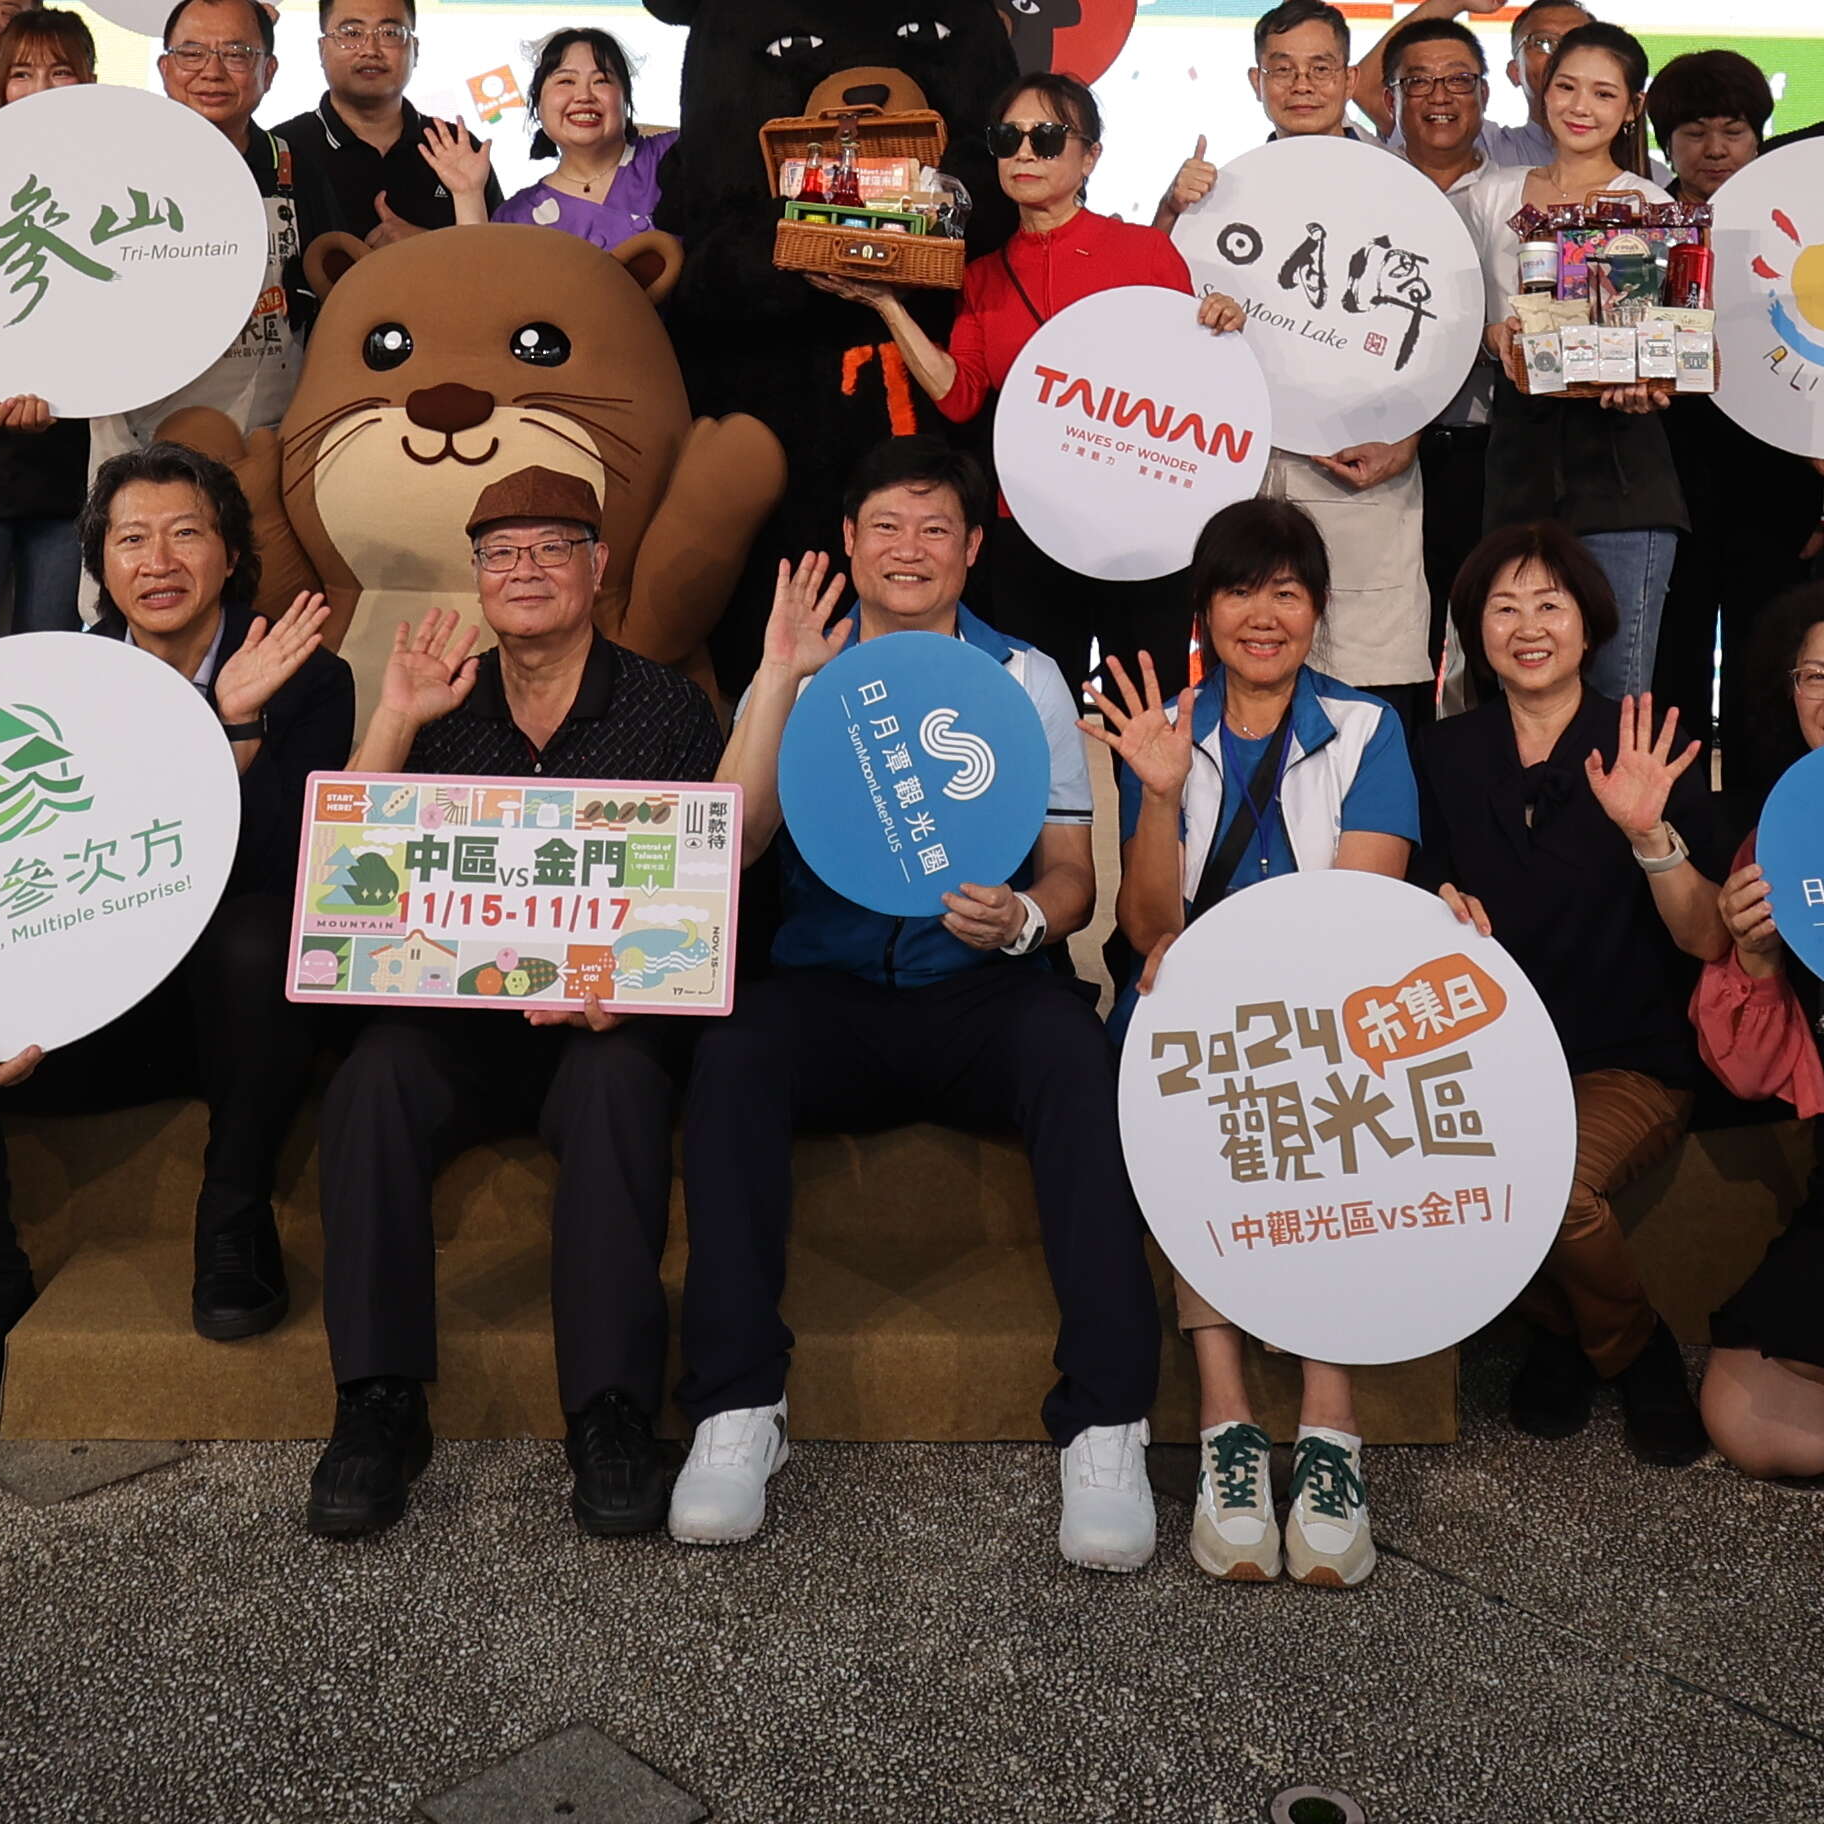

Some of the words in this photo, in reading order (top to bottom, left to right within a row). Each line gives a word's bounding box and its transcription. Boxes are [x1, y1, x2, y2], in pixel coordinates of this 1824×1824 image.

[120, 240, 238, 262] Tri-Mountain
[1242, 297, 1297, 332] Moon
[1300, 320, 1348, 350] Lake
[1034, 364, 1254, 464] TAIWAN
[1065, 425, 1113, 449] WAVES
[1115, 440, 1135, 455] OF
[1137, 447, 1199, 475] WONDER
[326, 793, 354, 803] START
[847, 723, 903, 854] SunMoonLakePLUS
[858, 679, 950, 876] 日月潭觀光圈
[326, 803, 353, 812] HERE!
[11, 907, 95, 944] Multiple
[101, 874, 193, 916] Surprise!
[316, 919, 394, 929] MOUNTAIN
[397, 889, 631, 933] 11/15-11/17
[711, 926, 721, 955] NOV.
[581, 963, 602, 972] Let's
[583, 973, 599, 982] GO!
[672, 987, 684, 996] 17
[1358, 973, 1489, 1054] 市集日
[1151, 1000, 1344, 1097] 2024
[1207, 1050, 1497, 1184] 觀光區
